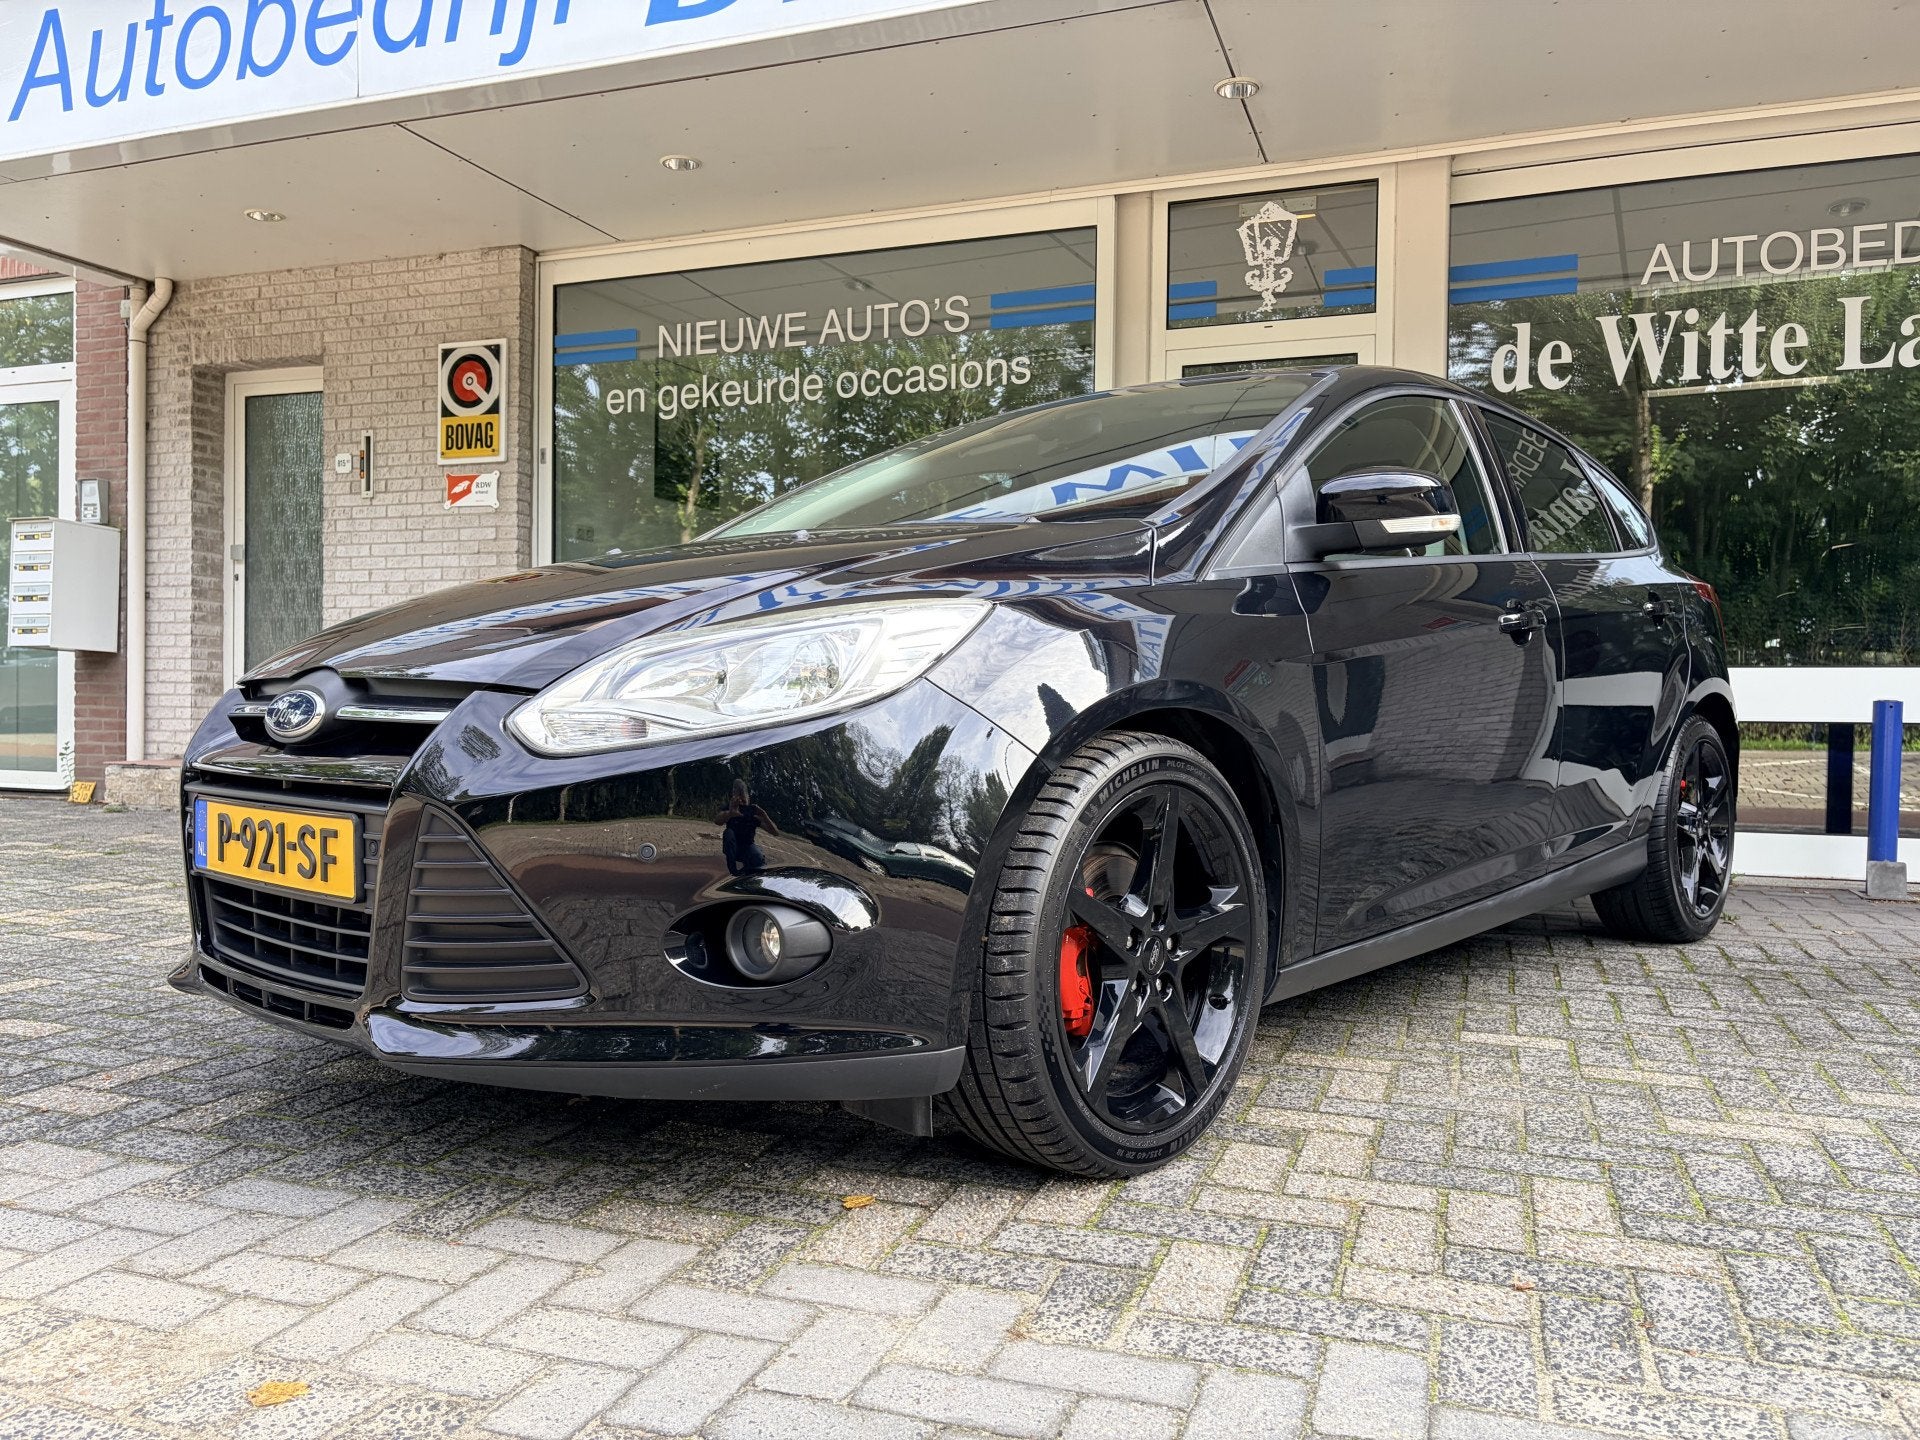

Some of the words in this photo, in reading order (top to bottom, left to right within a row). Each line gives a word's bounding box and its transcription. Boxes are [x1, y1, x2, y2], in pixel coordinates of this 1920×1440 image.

[7, 0, 571, 122] Autobedj
[658, 312, 806, 359] NIEUWE
[818, 295, 970, 346] AUTO'S
[1491, 323, 1573, 393] de
[1595, 308, 1809, 386] Witte
[606, 386, 645, 414] en
[658, 366, 823, 420] gekeurde
[836, 354, 1032, 399] occasions
[445, 421, 494, 450] BOVAG
[475, 481, 492, 489] RDW
[1098, 758, 1161, 804] MICHELIN
[1166, 759, 1186, 769] PILOT
[197, 840, 207, 857] NL
[217, 812, 339, 883] P-921-SF
